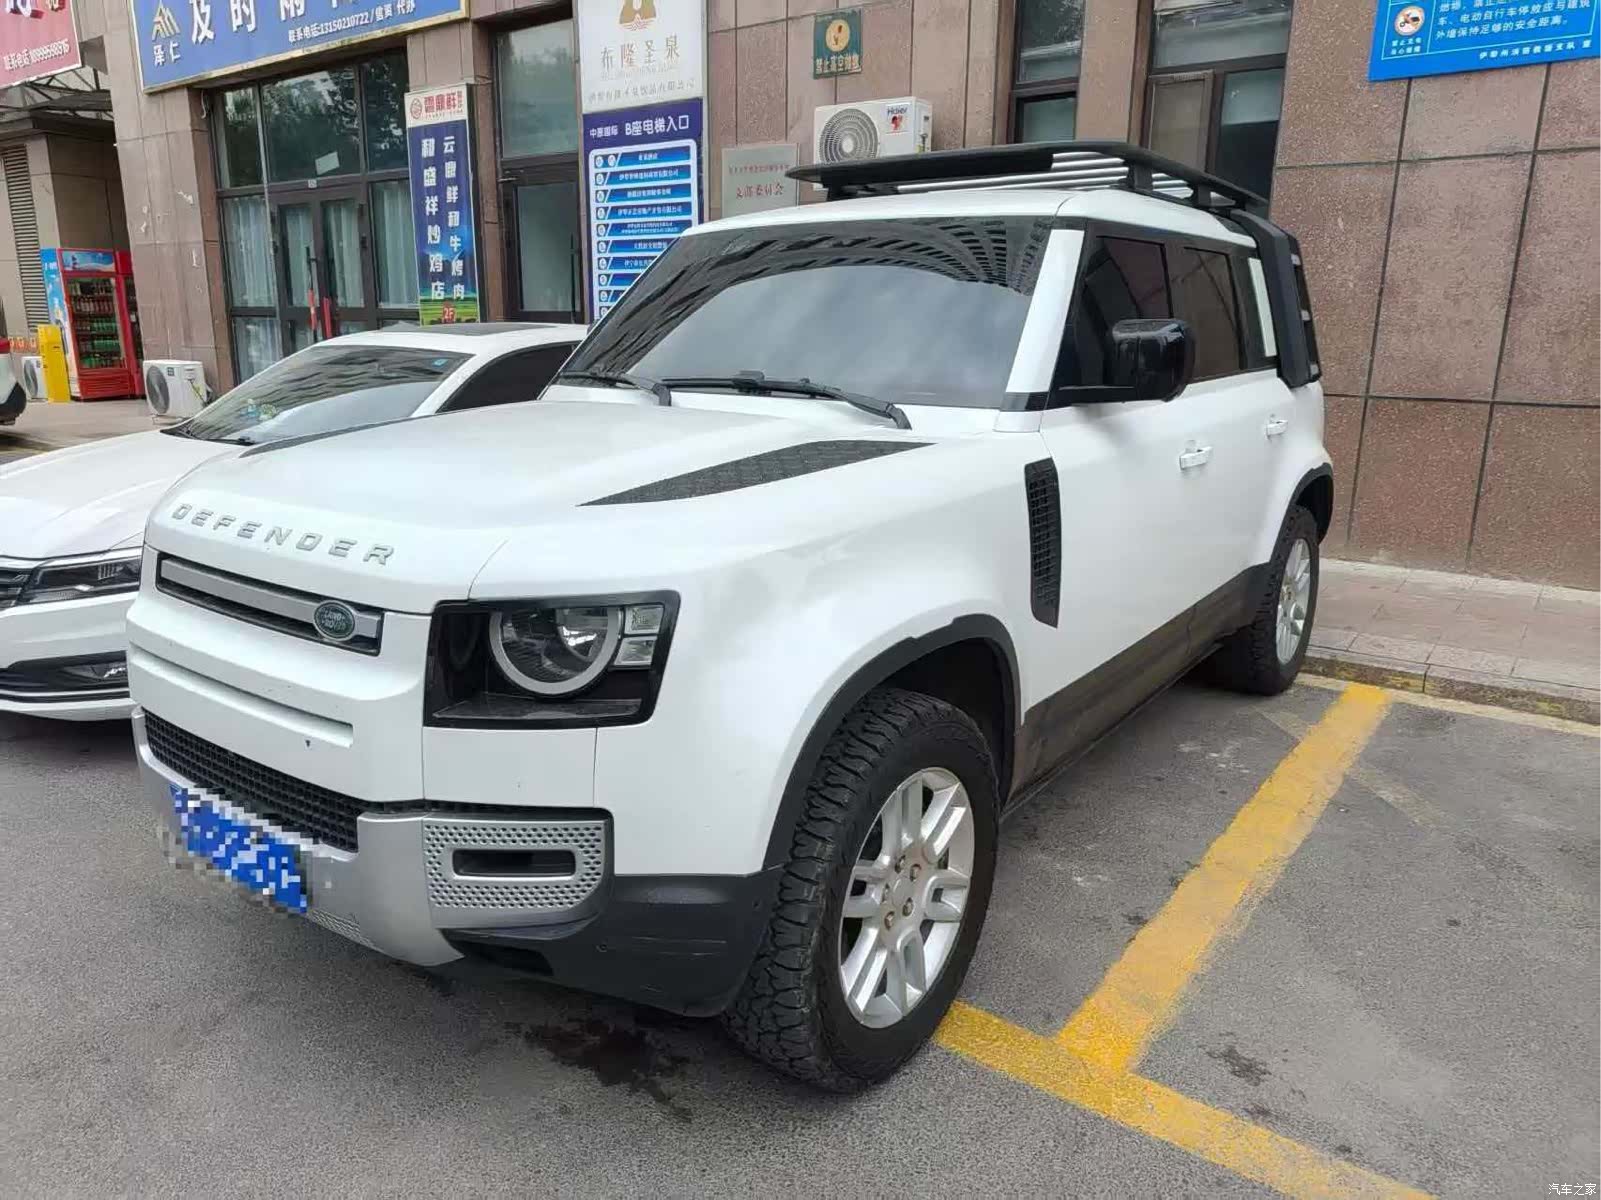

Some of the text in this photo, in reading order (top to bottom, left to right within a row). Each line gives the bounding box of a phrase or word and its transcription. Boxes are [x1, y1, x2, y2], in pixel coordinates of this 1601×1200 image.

[153, 41, 181, 67] 泽仁
[600, 34, 681, 71] 布隆圣泉
[887, 105, 908, 116] Haier
[625, 115, 690, 136] B座电梯入口
[172, 503, 395, 566] DEFENDER
